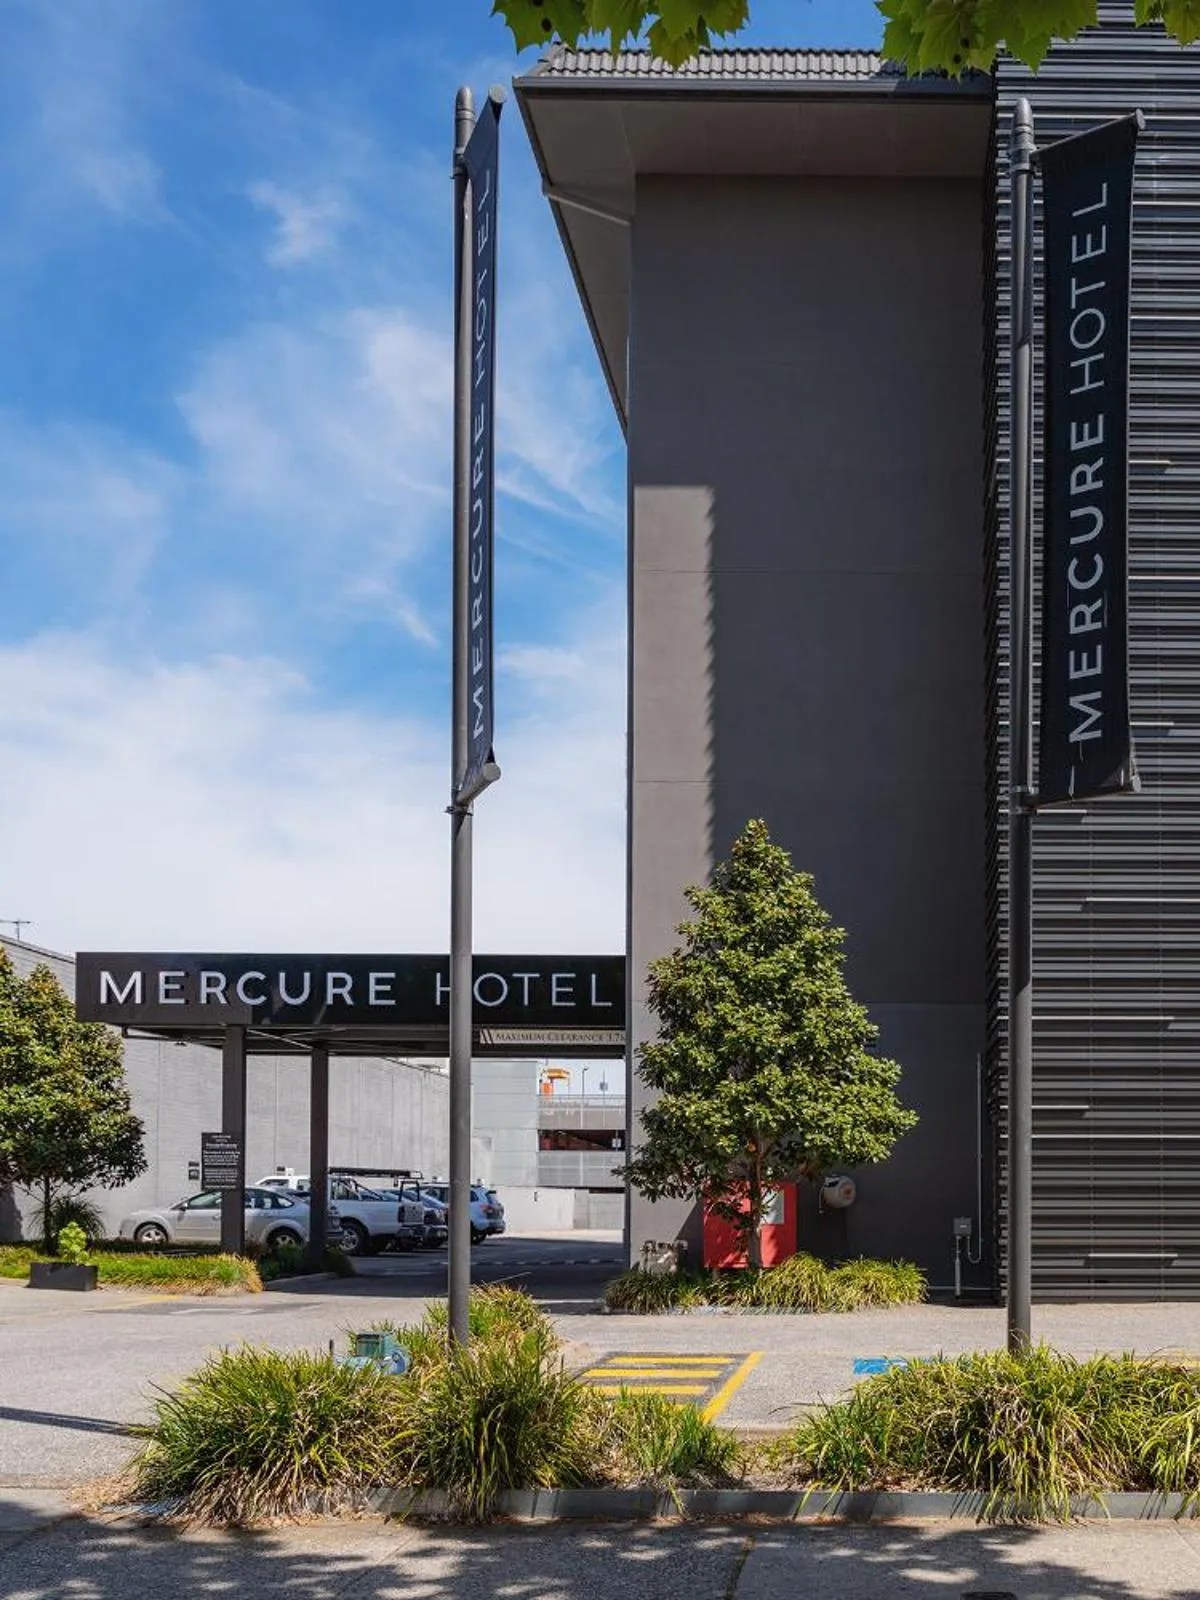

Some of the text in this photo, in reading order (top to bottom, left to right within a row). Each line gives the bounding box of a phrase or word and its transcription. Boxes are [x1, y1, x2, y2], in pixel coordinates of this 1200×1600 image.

[472, 168, 491, 740] MERCURE HOTEL
[1068, 182, 1108, 744] MERCURE HOTEL
[99, 970, 396, 1006] MERCURE
